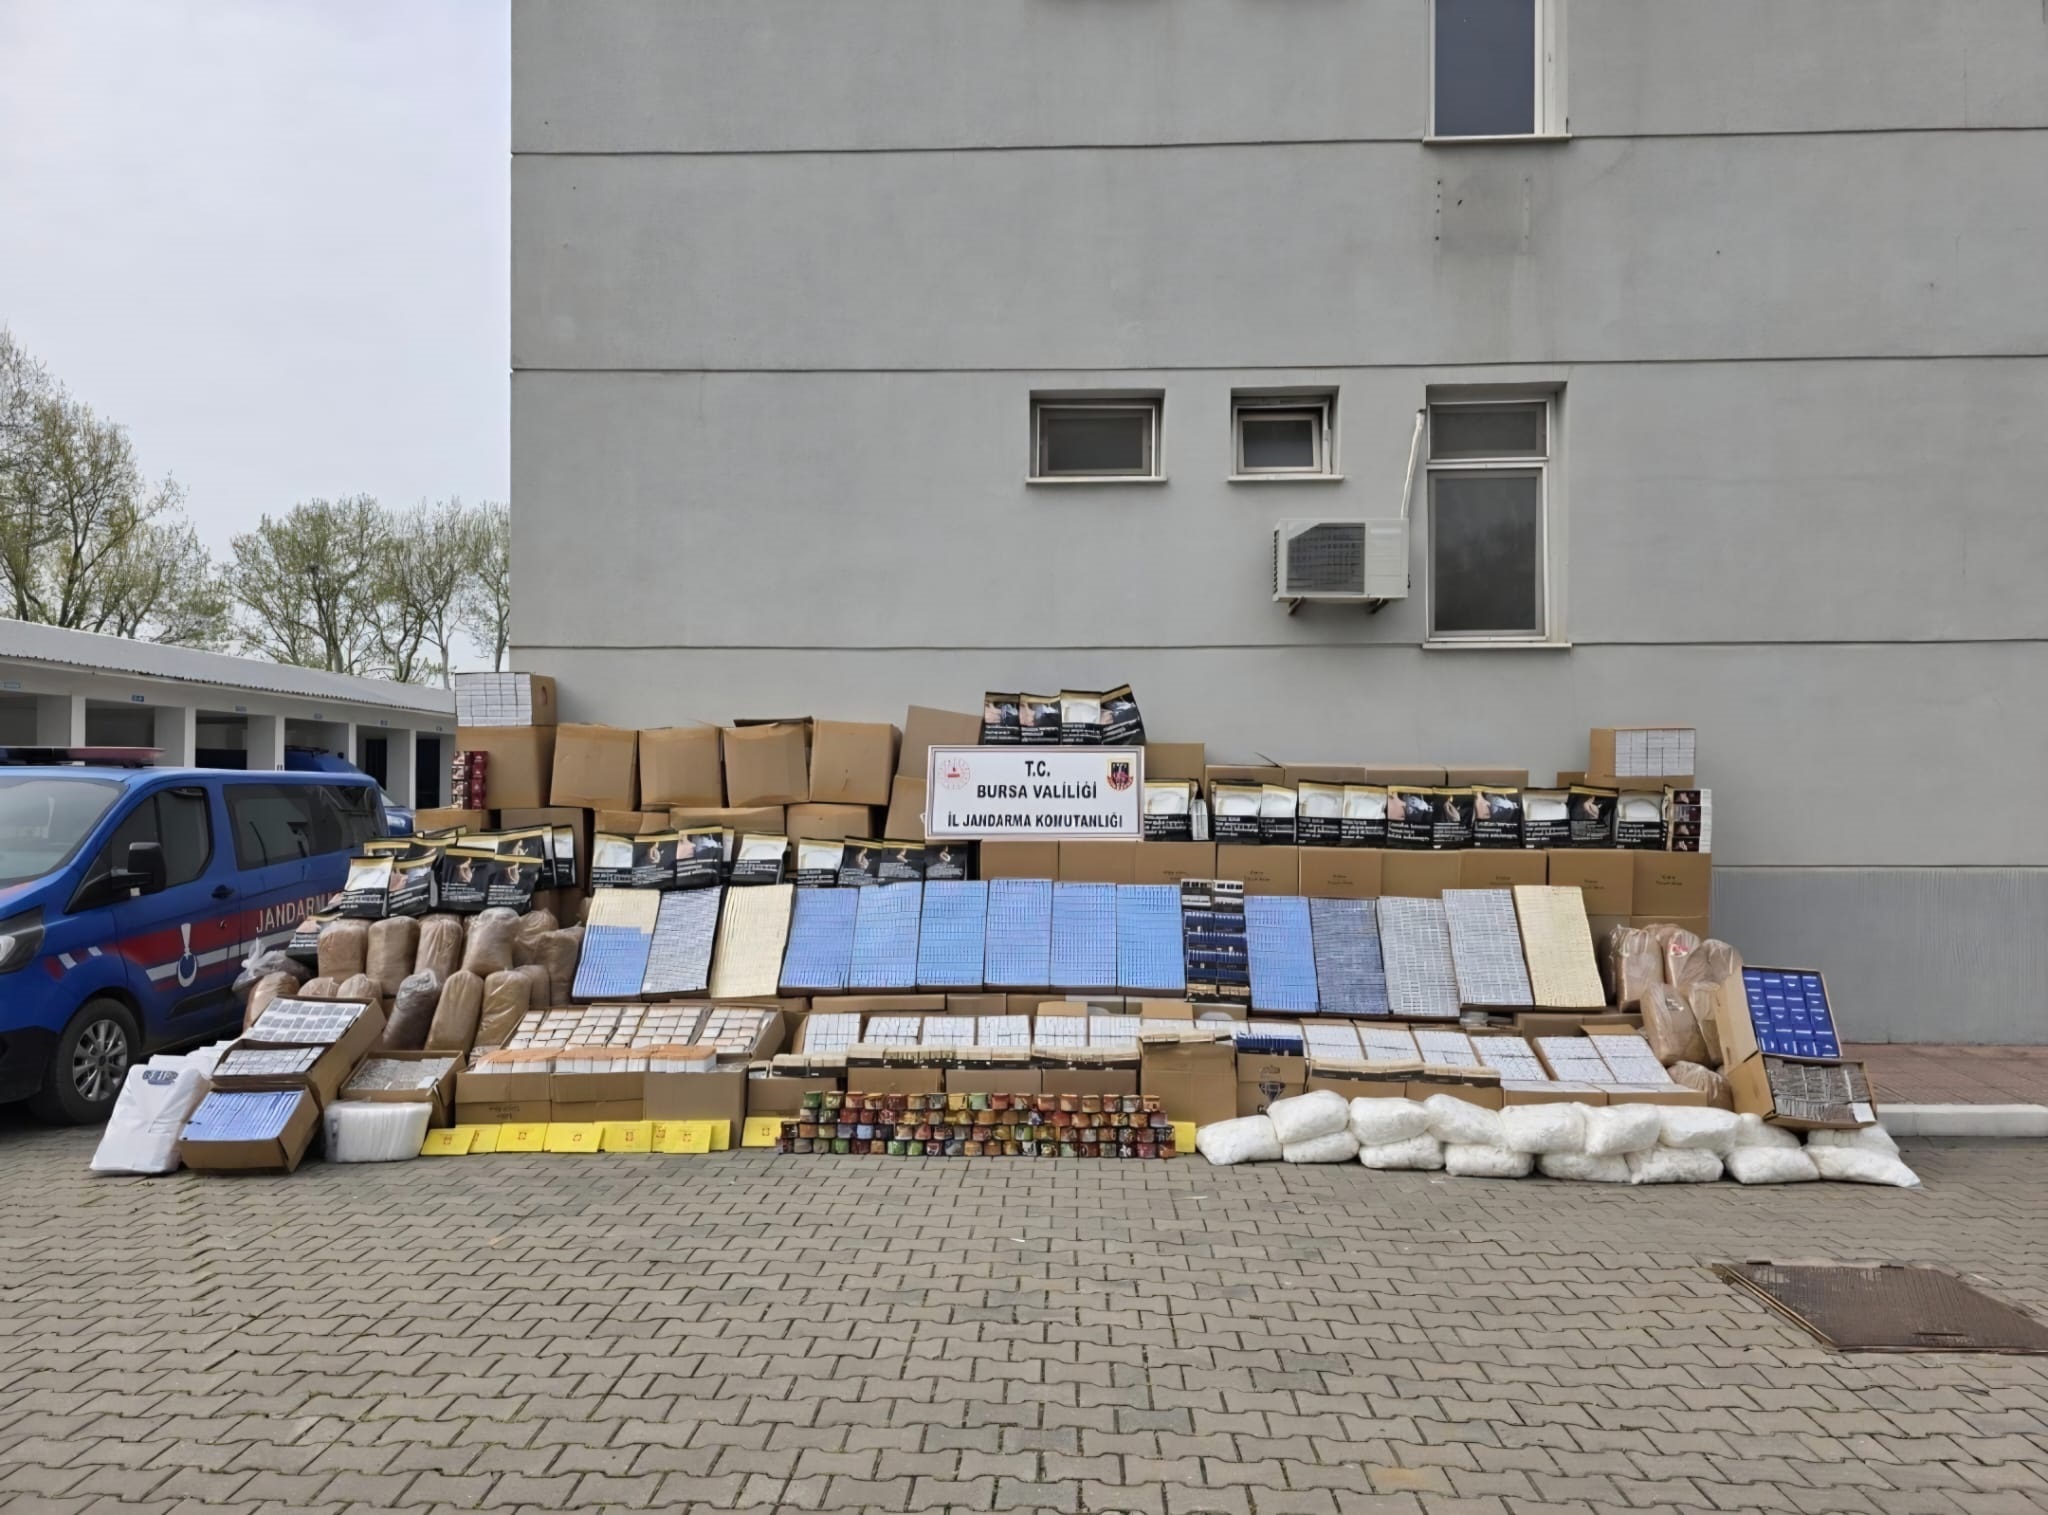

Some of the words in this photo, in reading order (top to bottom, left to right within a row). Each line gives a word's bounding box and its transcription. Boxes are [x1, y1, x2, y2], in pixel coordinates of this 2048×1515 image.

[1025, 760, 1051, 777] T.C.
[977, 784, 1028, 799] BURSA
[1032, 781, 1097, 799] VALİLİĞİ
[947, 811, 960, 827] İL
[962, 814, 1031, 827] JANDARMA
[1035, 812, 1122, 828] KOMUTANLIĞI
[256, 892, 333, 933] JANDARM
